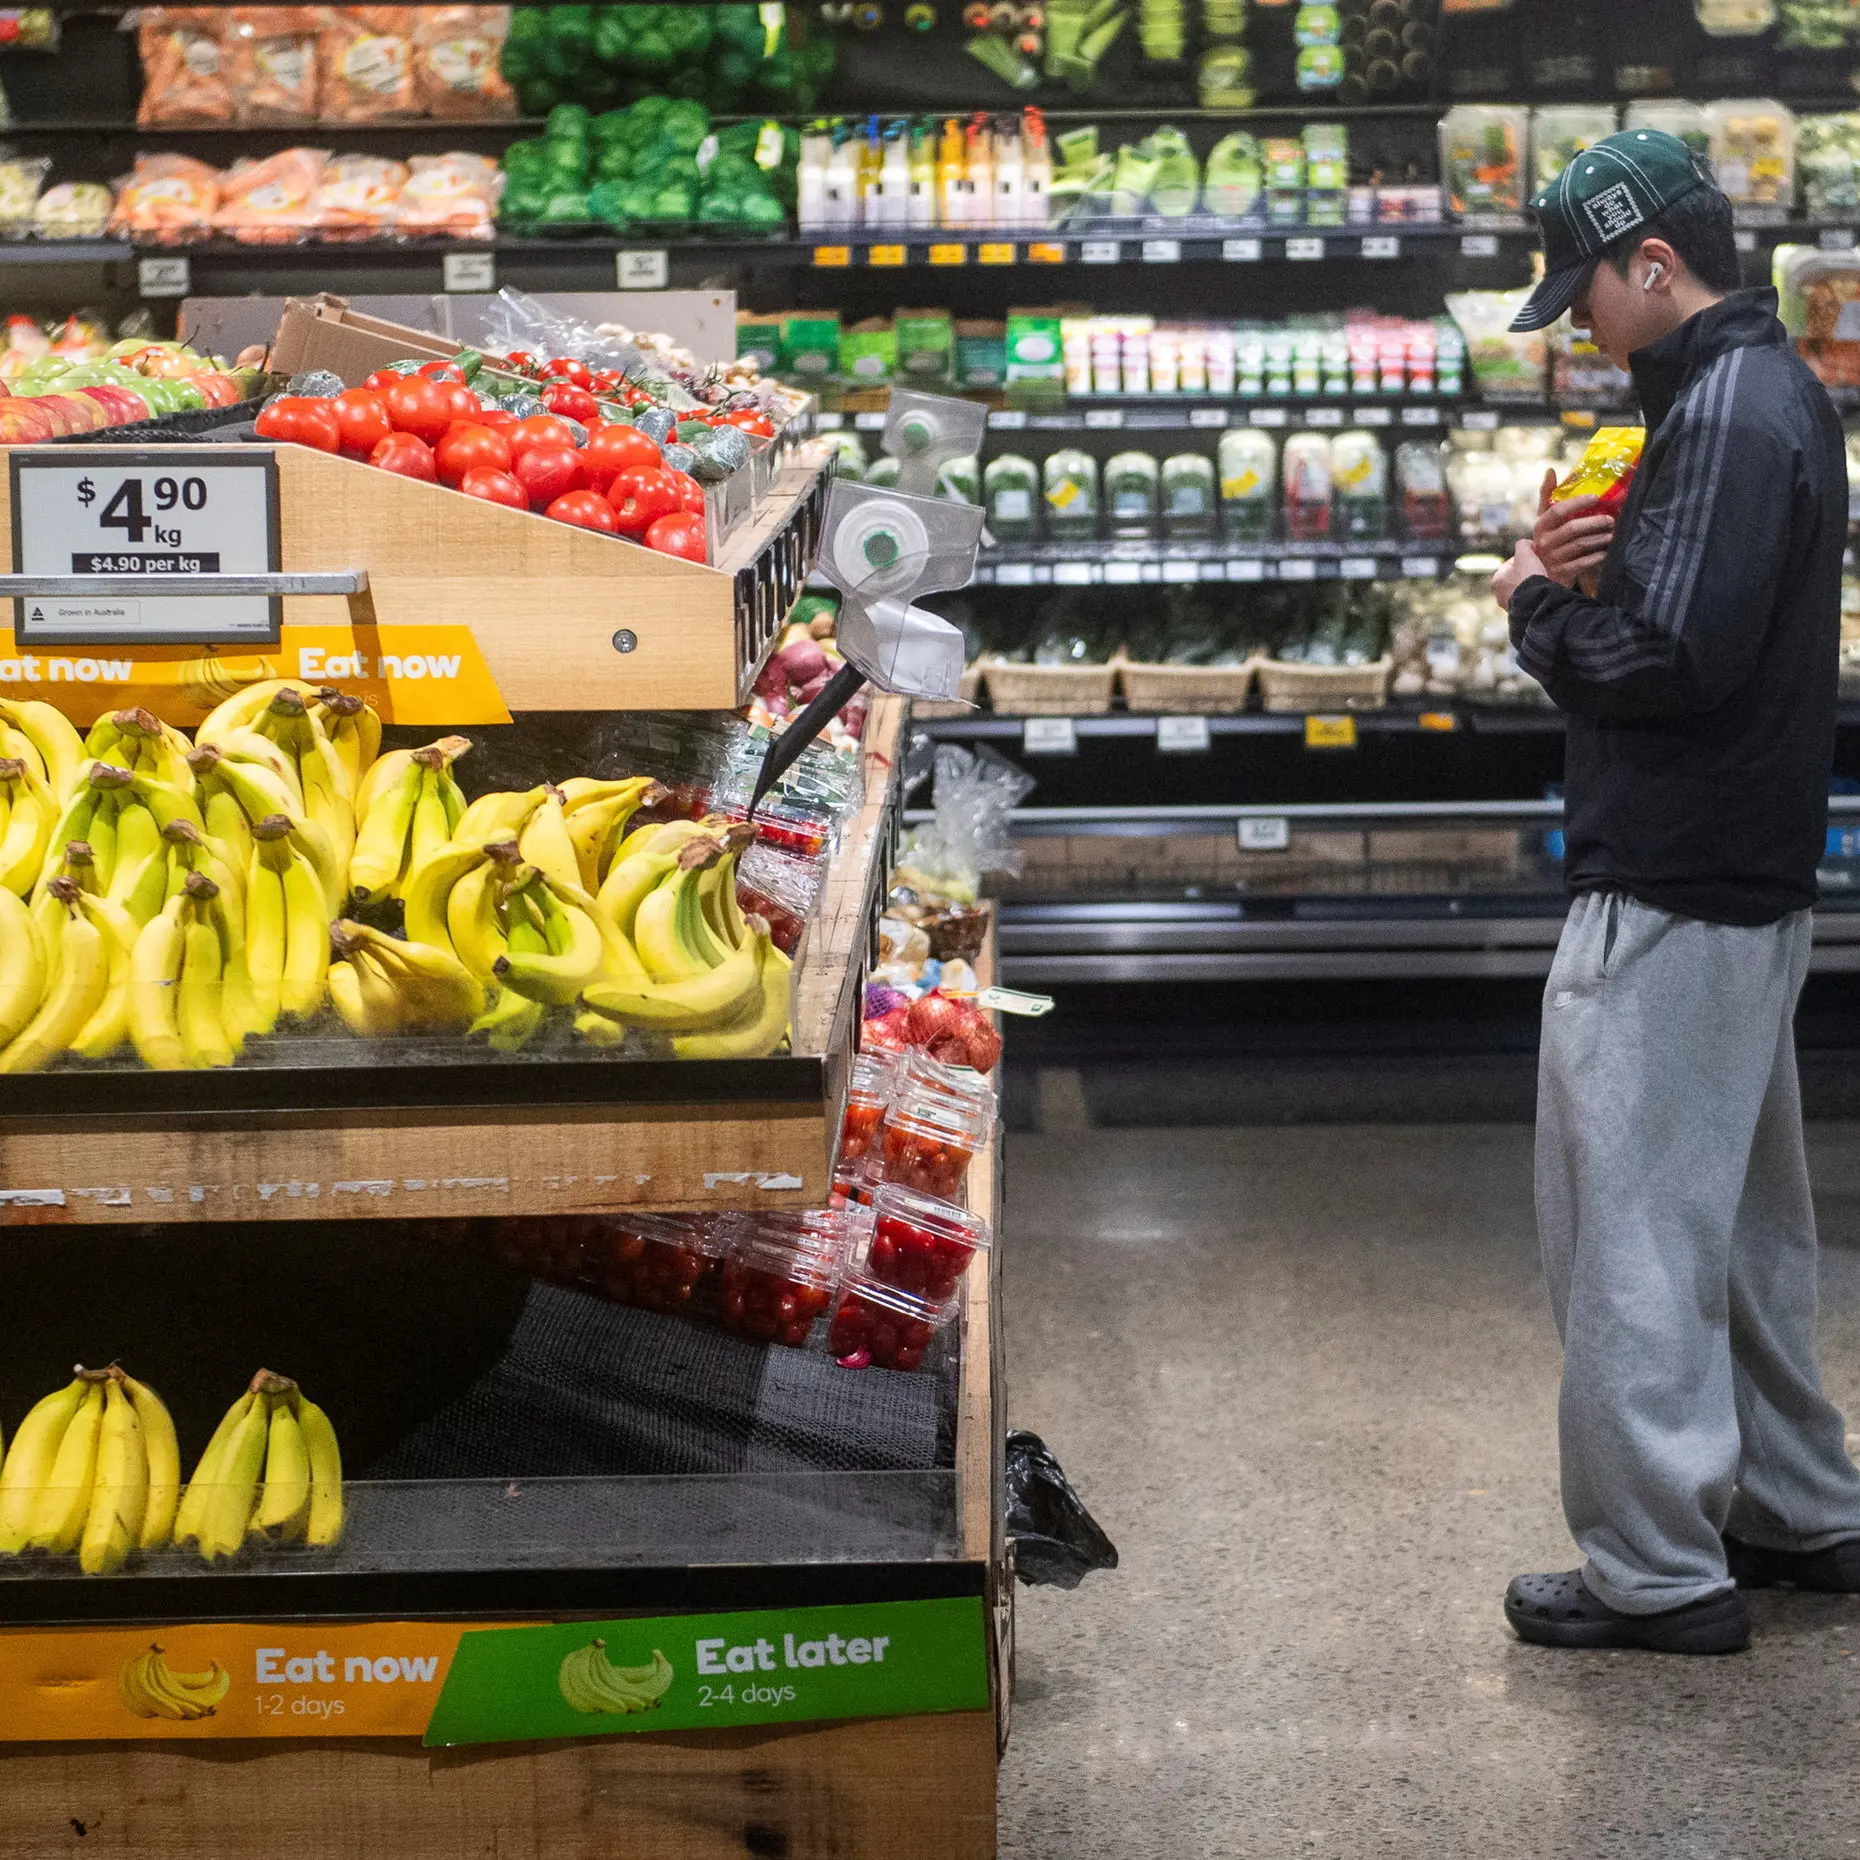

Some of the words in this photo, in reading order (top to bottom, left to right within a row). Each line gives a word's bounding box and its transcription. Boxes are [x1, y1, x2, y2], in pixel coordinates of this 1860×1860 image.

[1592, 190, 1622, 209] always
[1601, 202, 1623, 217] what
[1604, 209, 1631, 229] should
[1607, 209, 1624, 220] you
[154, 525, 182, 547] kg
[91, 556, 140, 573] $4.90
[146, 558, 175, 573] per
[179, 556, 200, 573] kg
[58, 608, 82, 617] Grown
[84, 608, 91, 616] in
[94, 608, 125, 617] Australia
[0, 654, 41, 682] at
[48, 657, 133, 682] now
[299, 648, 368, 679] Eat
[378, 655, 461, 679] now
[696, 1638, 776, 1674] Eat
[784, 1633, 889, 1668] later
[256, 1648, 335, 1683] Eat
[344, 1656, 439, 1683] now
[698, 1684, 735, 1706] 2-4
[741, 1683, 796, 1707] days
[254, 1695, 284, 1715] 1-2
[291, 1695, 345, 1720] days
